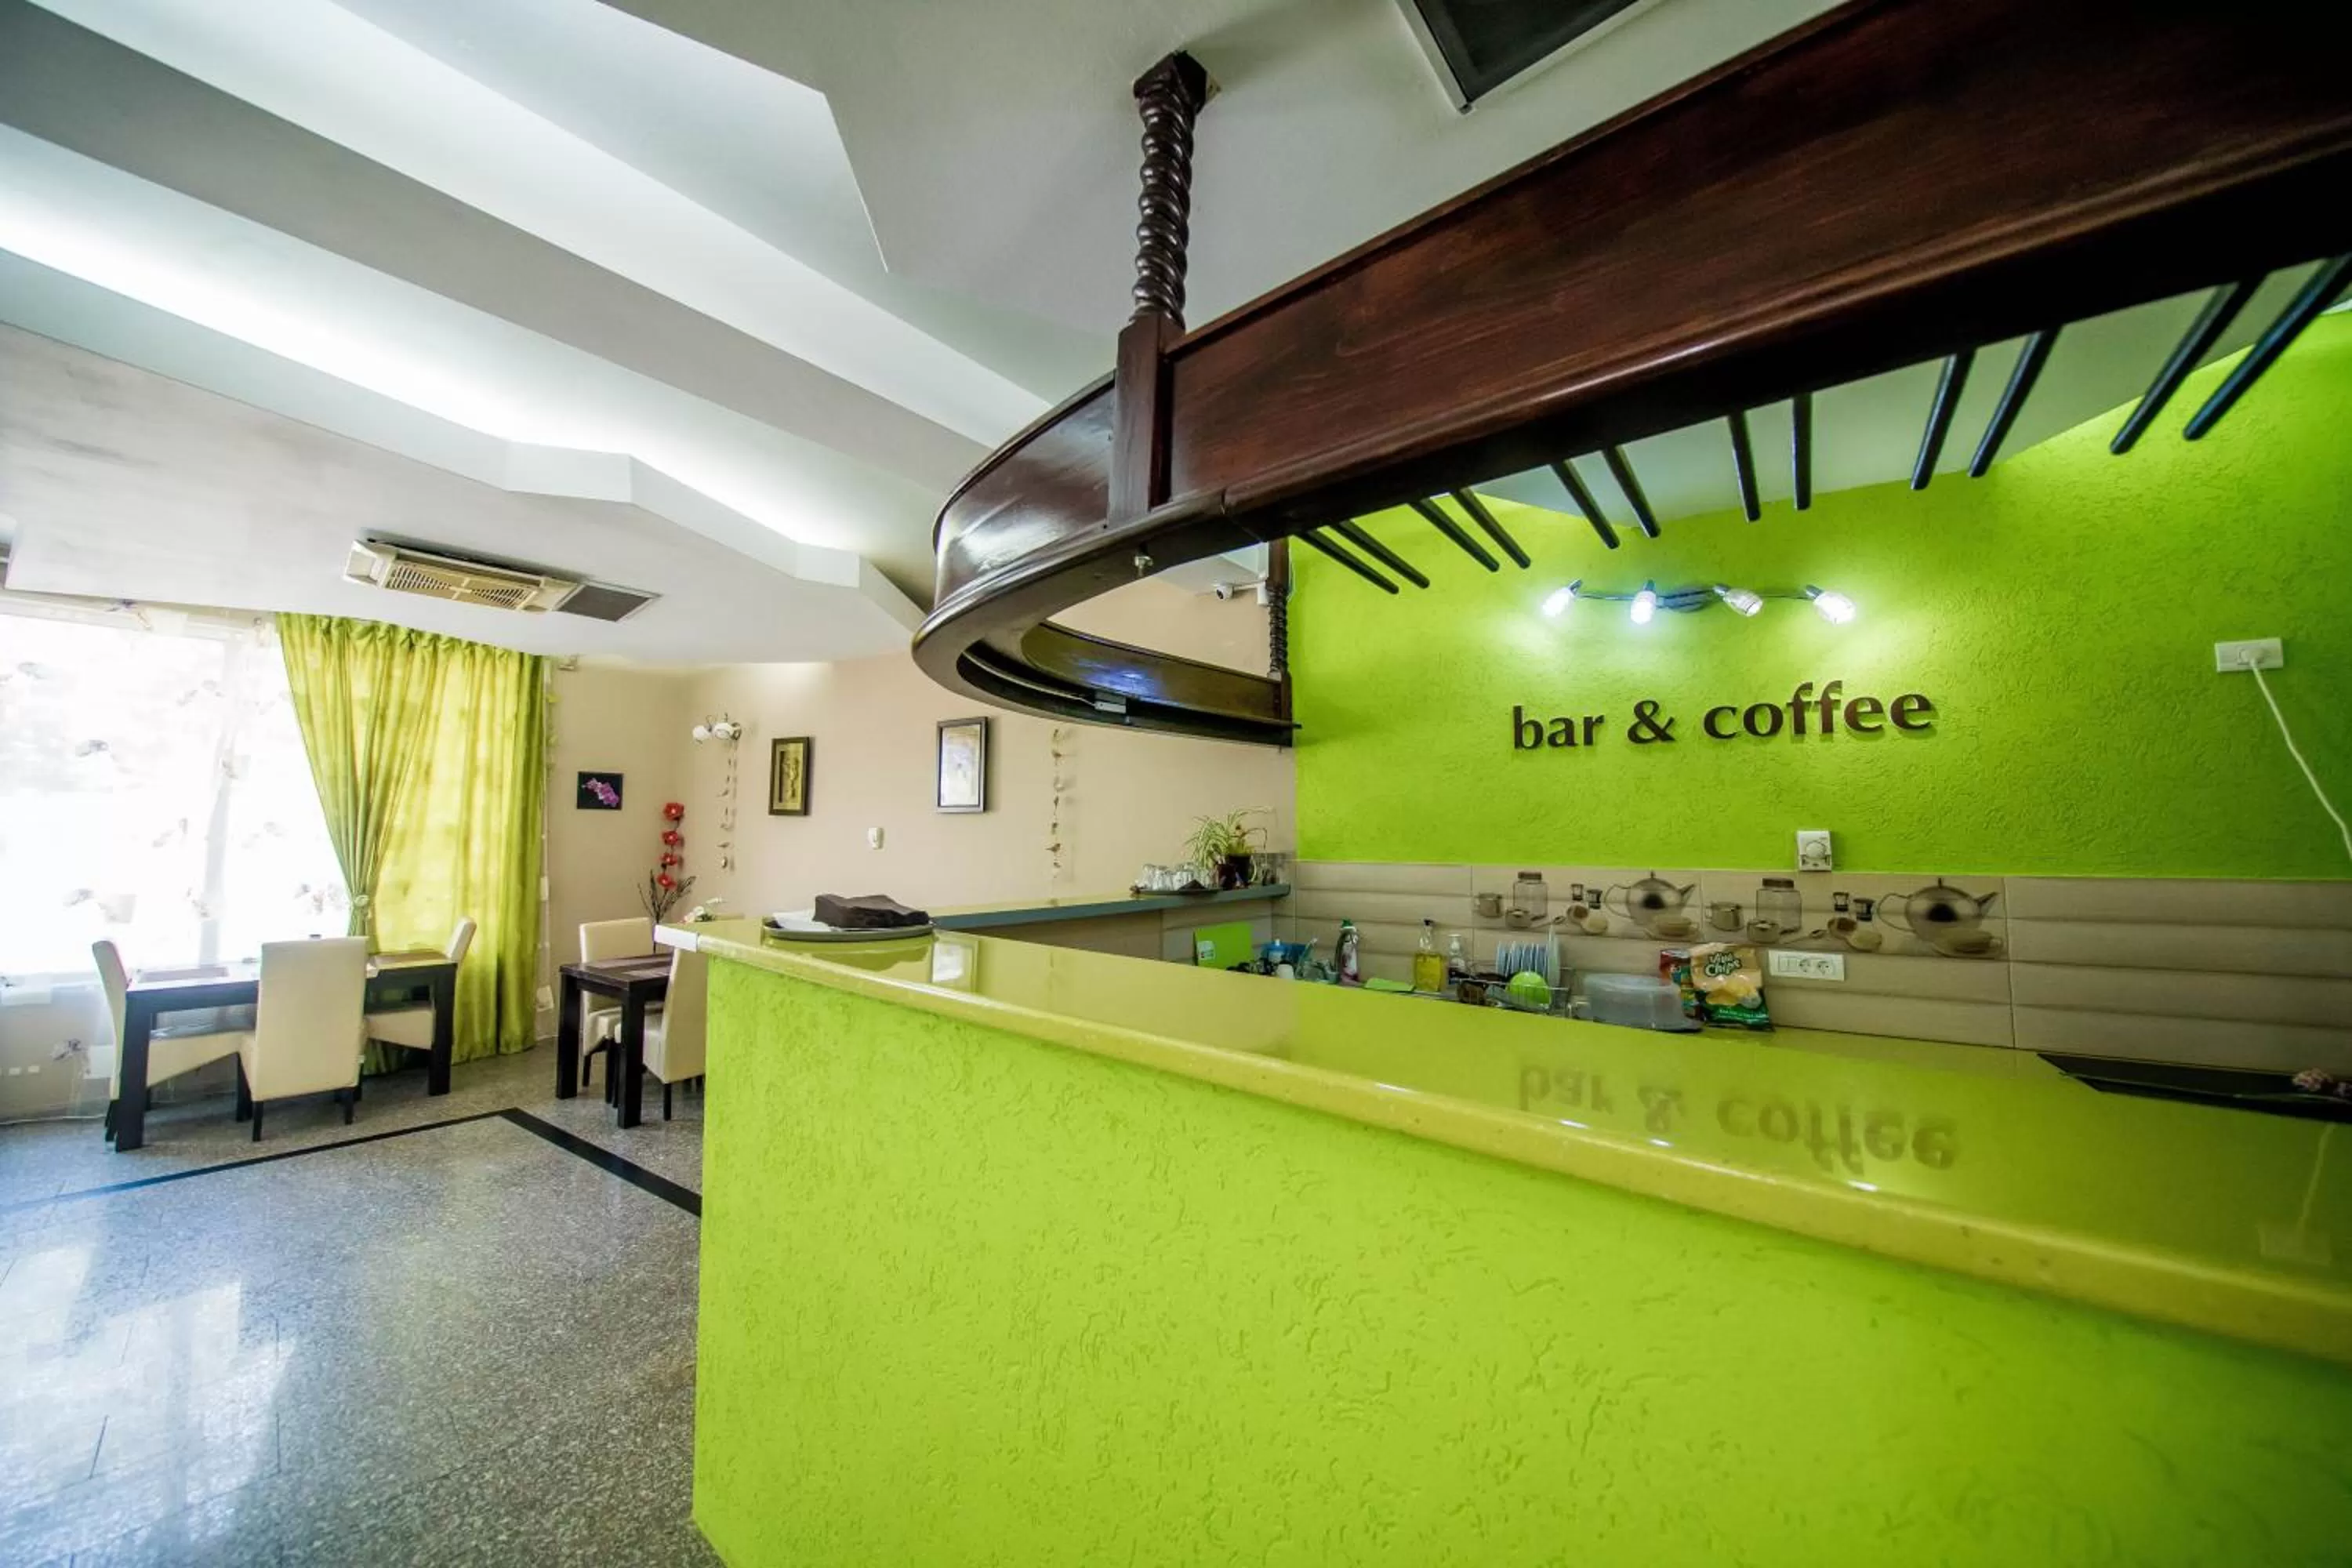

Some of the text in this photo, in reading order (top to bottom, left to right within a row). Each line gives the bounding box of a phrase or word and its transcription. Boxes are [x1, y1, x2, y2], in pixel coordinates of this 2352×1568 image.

[1513, 681, 1933, 750] bar & coffee
